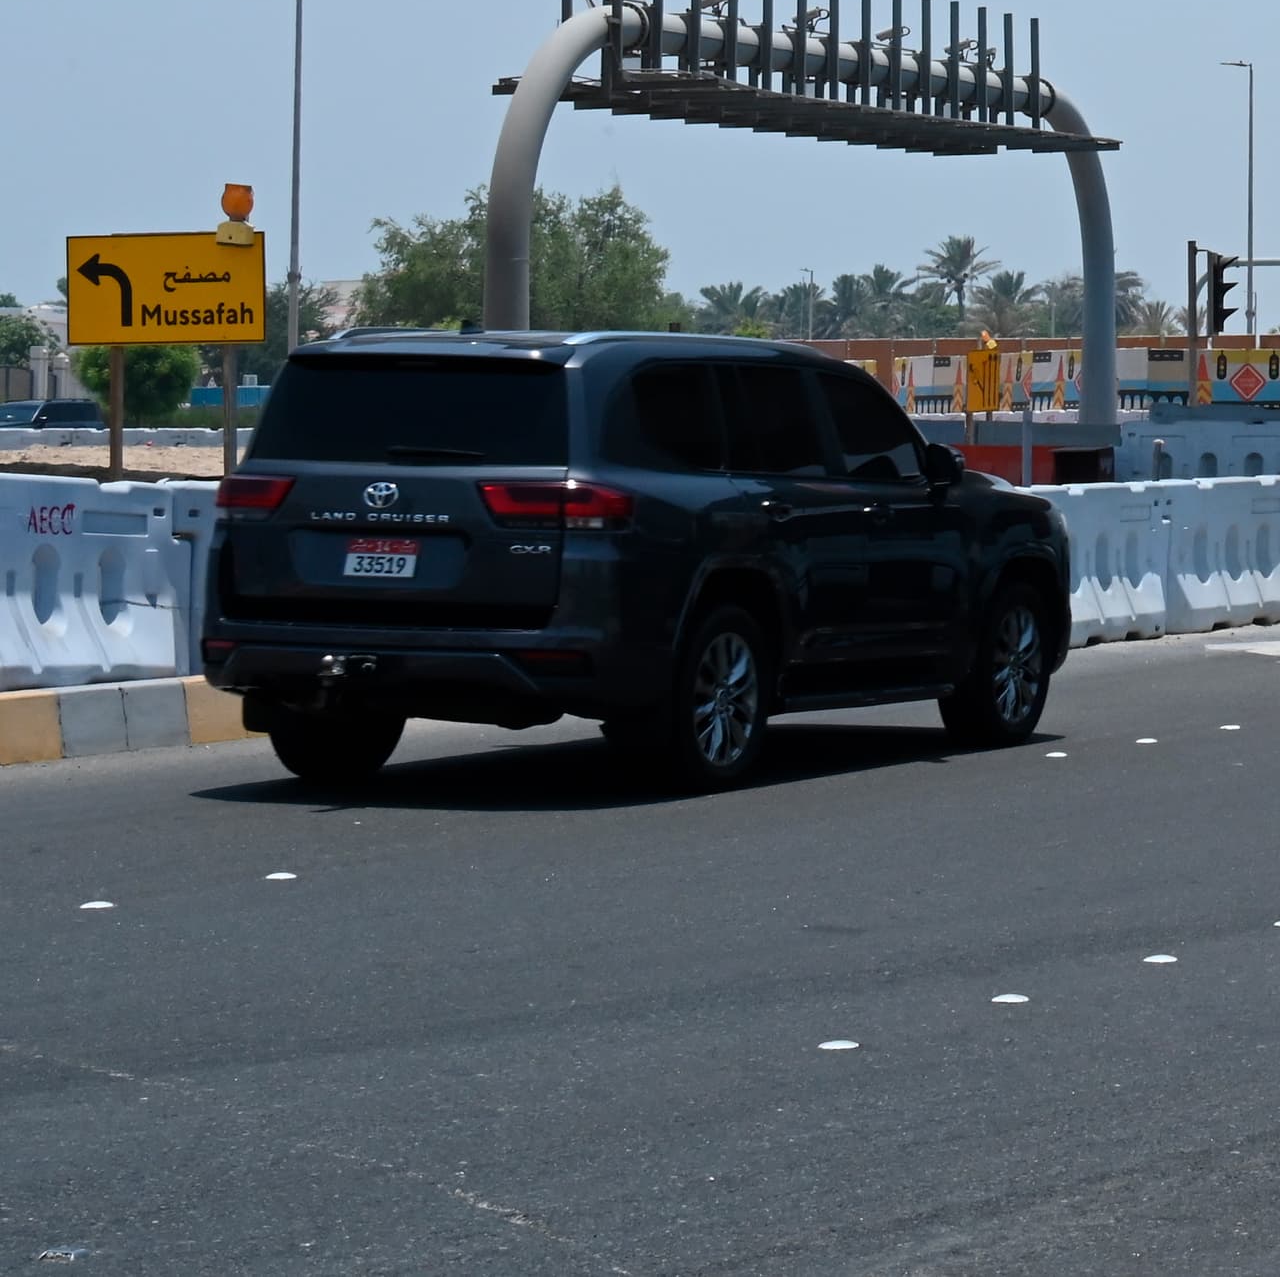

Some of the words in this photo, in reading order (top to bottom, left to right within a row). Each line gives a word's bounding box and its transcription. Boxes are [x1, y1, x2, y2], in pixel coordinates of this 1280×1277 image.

[163, 266, 231, 293] مصفح
[141, 302, 254, 327] Mussafah
[27, 505, 76, 535] AECC
[311, 511, 356, 521] LAND
[368, 512, 450, 523] CRUISER
[509, 544, 552, 555] GXR
[353, 555, 407, 574] 33519
